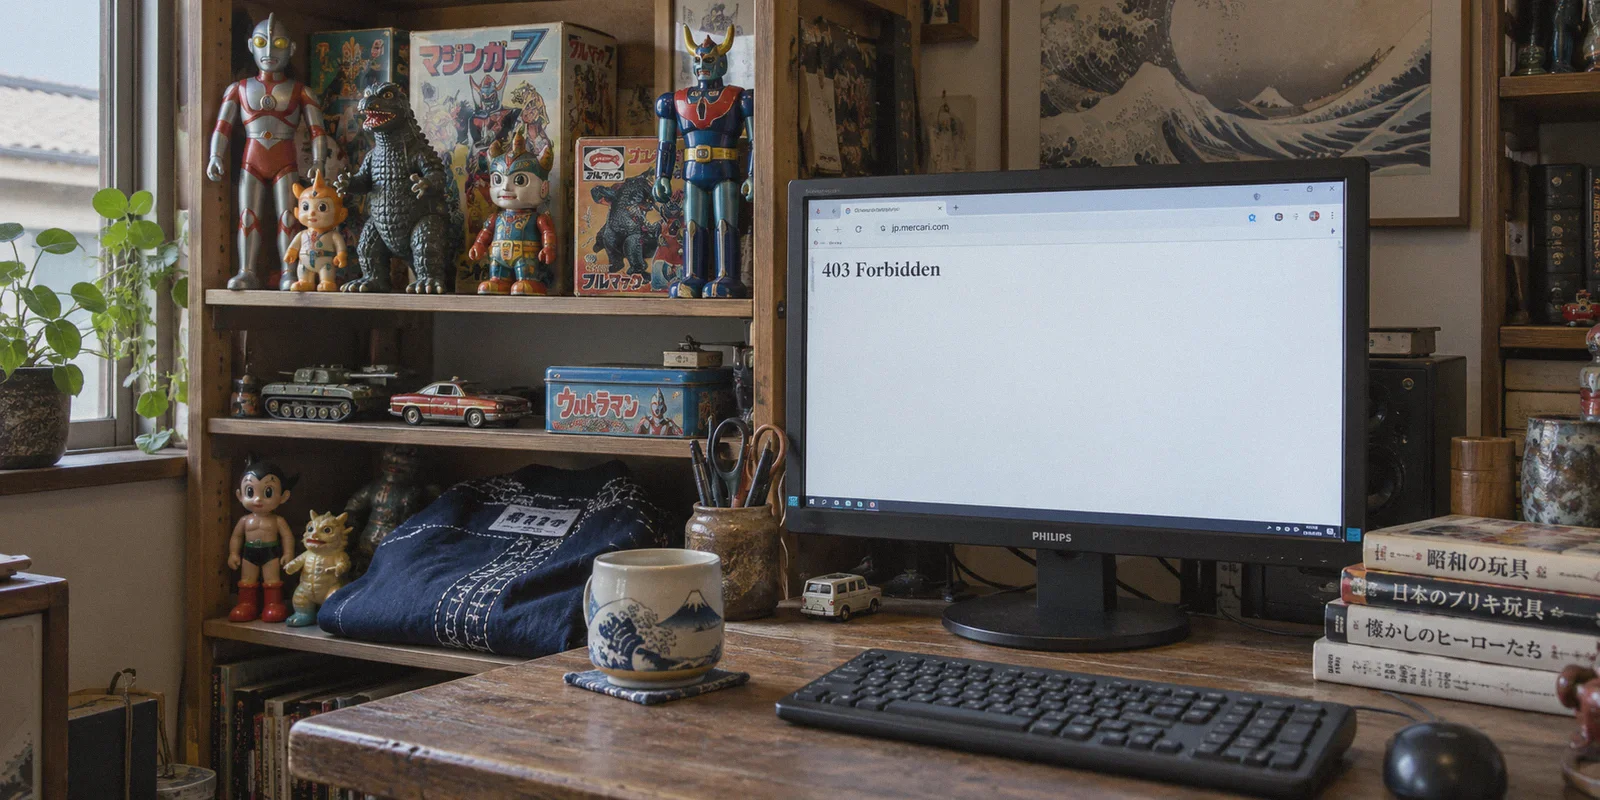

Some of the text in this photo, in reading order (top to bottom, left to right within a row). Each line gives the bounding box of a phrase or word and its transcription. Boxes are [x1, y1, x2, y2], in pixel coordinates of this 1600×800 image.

[892, 223, 949, 233] jp.mercari.com
[822, 261, 940, 277] 403 Forbidden
[557, 386, 639, 419] ウルトラマン
[1032, 531, 1072, 542] PHILIPS
[1427, 549, 1530, 580] 昭和の玩具
[1393, 582, 1544, 620] 日本のブリキ玩具
